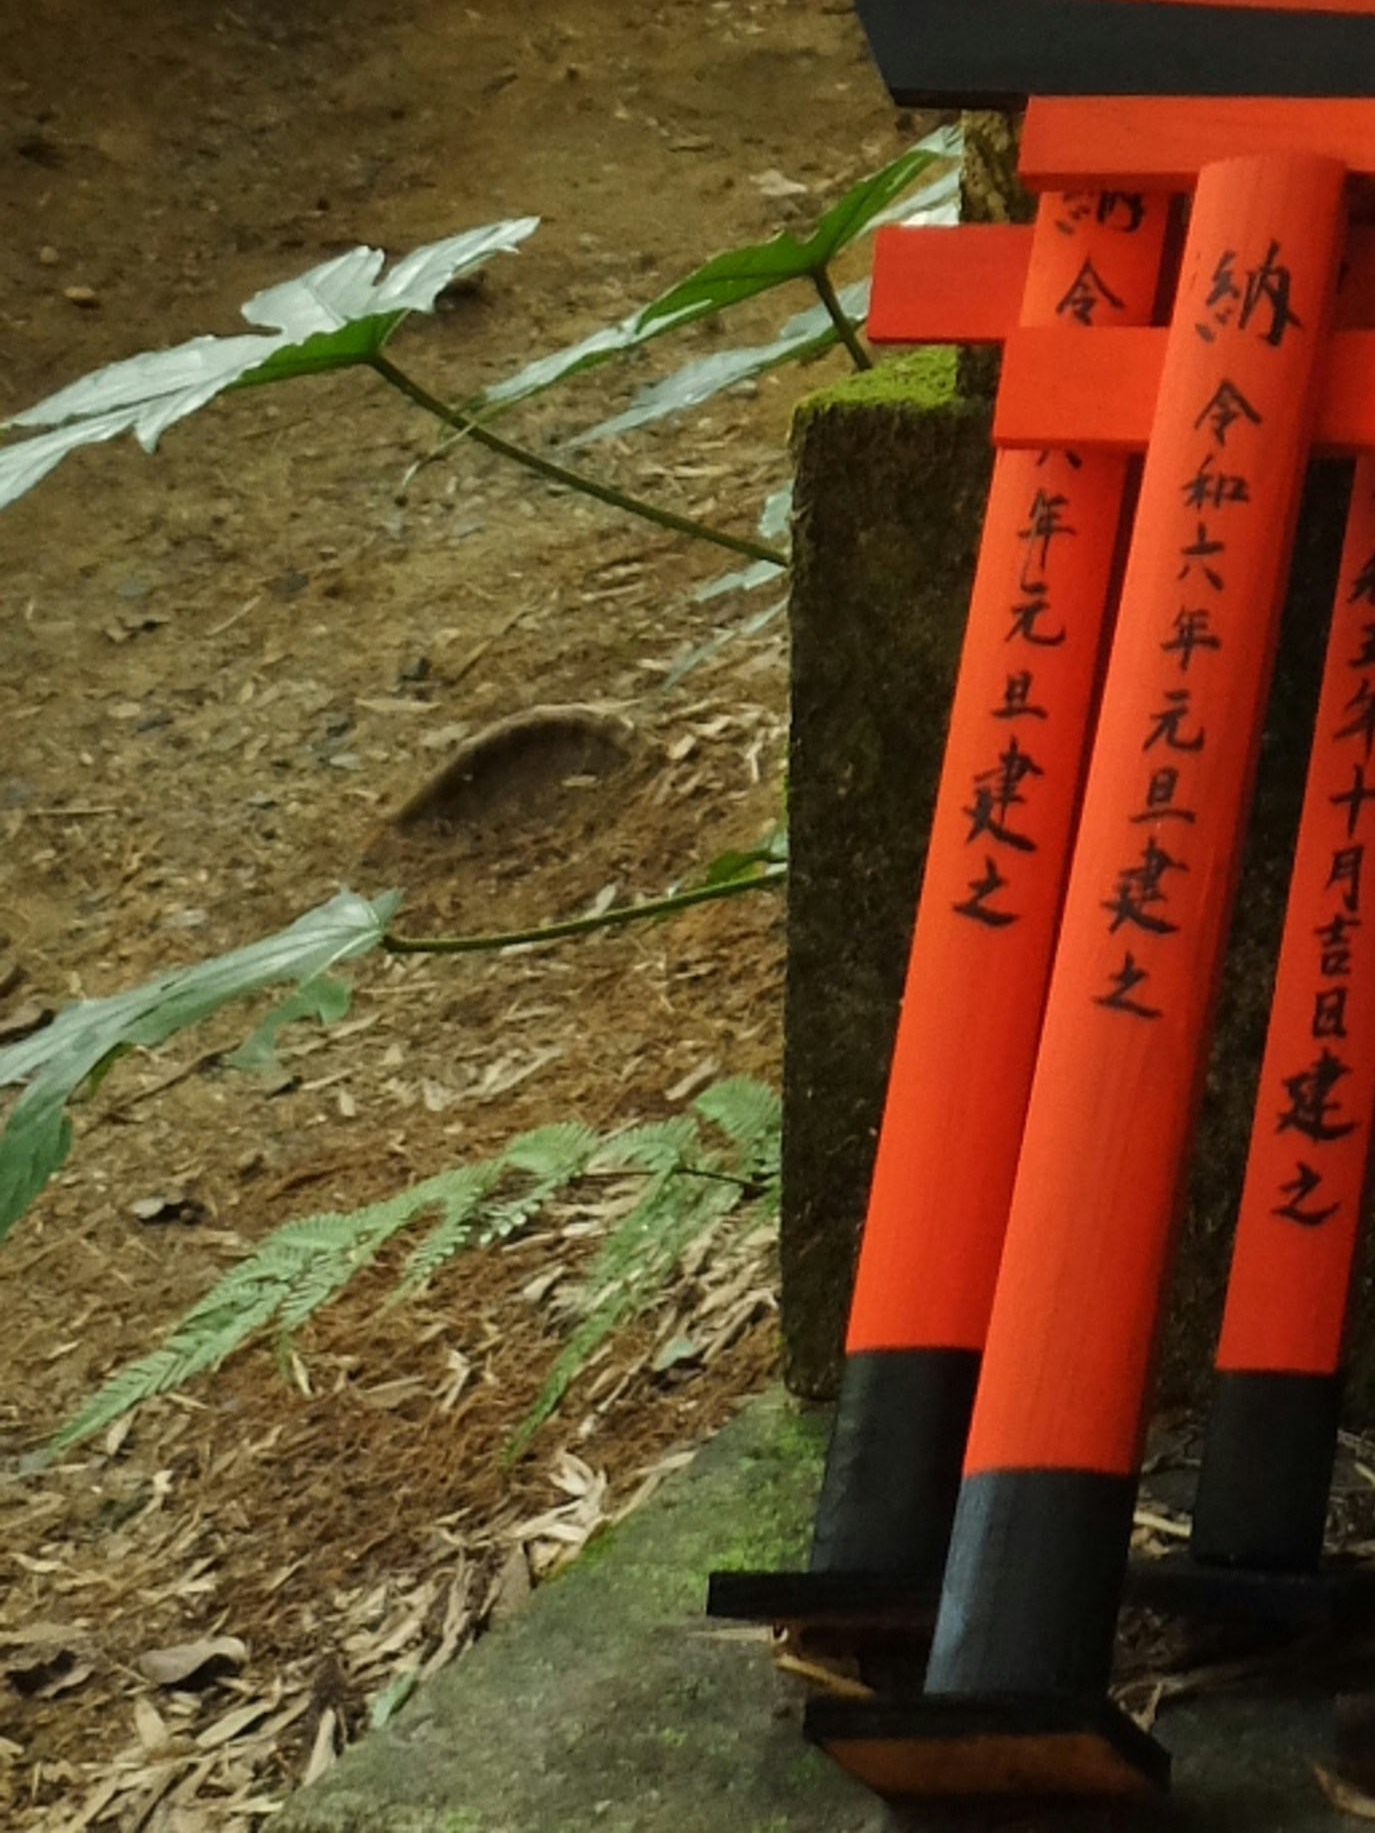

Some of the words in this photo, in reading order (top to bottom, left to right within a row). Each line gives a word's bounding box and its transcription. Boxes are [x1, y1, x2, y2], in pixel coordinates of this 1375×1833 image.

[1195, 238, 1302, 347] 納
[1092, 378, 1262, 1021] 令和六年元旦建之
